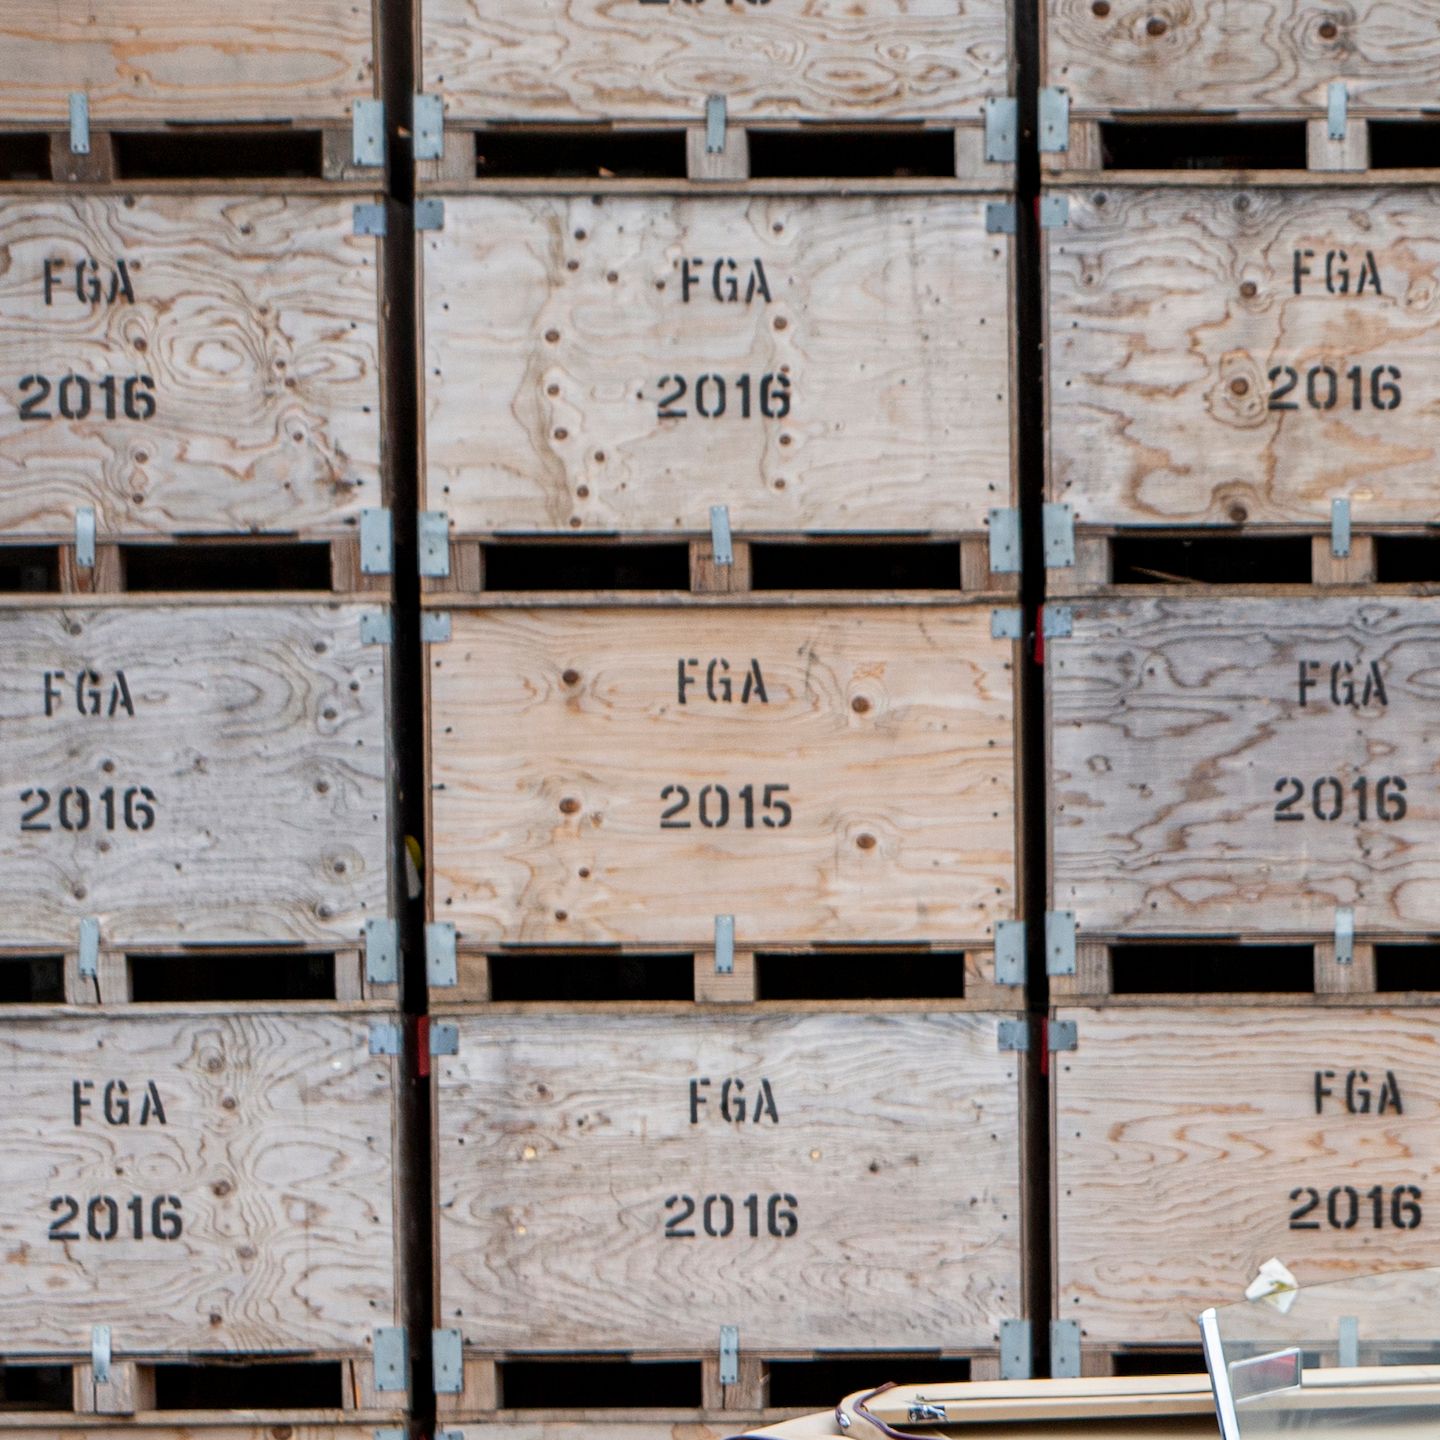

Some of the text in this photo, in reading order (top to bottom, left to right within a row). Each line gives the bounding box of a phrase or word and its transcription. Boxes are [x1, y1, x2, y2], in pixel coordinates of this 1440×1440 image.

[43, 259, 136, 305] FGA
[680, 259, 771, 303] FGA
[1293, 250, 1384, 297] FGA
[19, 375, 156, 421] 2016
[656, 373, 791, 420] 2016
[1268, 365, 1402, 412] 2016
[43, 671, 136, 716] FGA
[677, 658, 767, 705] FGA
[1298, 660, 1390, 708] FGA
[19, 787, 156, 832] 2016
[659, 783, 792, 829] 2015
[1274, 776, 1408, 823] 2016
[72, 1080, 167, 1127] FGA
[688, 1079, 778, 1124] FGA
[1313, 1070, 1404, 1116] FGA
[49, 1195, 184, 1241] 2016
[665, 1193, 799, 1238] 2016
[1289, 1184, 1423, 1230] 2016
